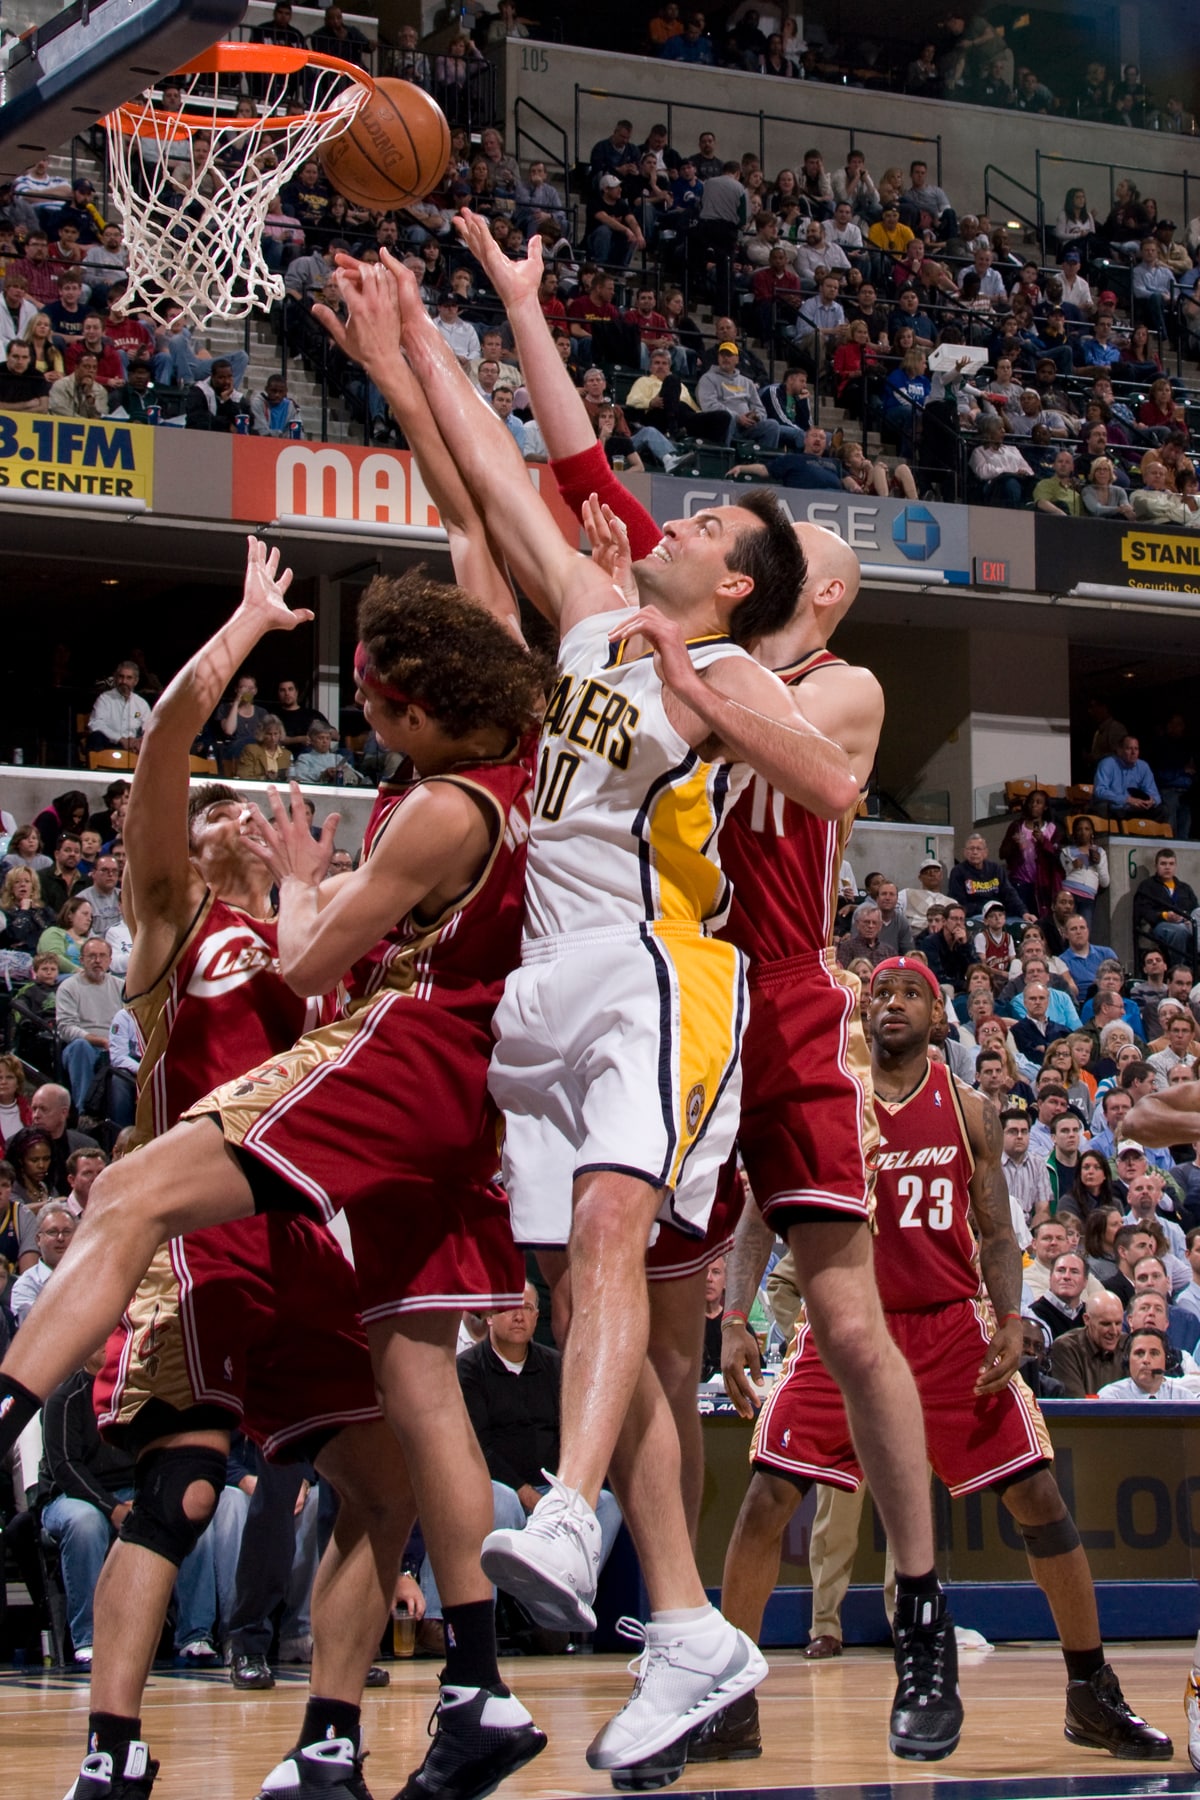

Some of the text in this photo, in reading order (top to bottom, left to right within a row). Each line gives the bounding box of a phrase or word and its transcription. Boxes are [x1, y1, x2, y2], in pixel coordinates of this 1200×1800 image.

[521, 47, 549, 72] 105
[359, 103, 405, 167] ALDING
[114, 336, 139, 347] NDIANA
[21, 469, 134, 497] CENTER
[683, 490, 881, 551] CSE
[982, 561, 1006, 582] EXIT
[541, 673, 641, 772] ACERS
[533, 745, 582, 822] 10
[1128, 848, 1138, 879] 6
[876, 1144, 959, 1172] ELAND
[897, 1174, 954, 1231] 23
